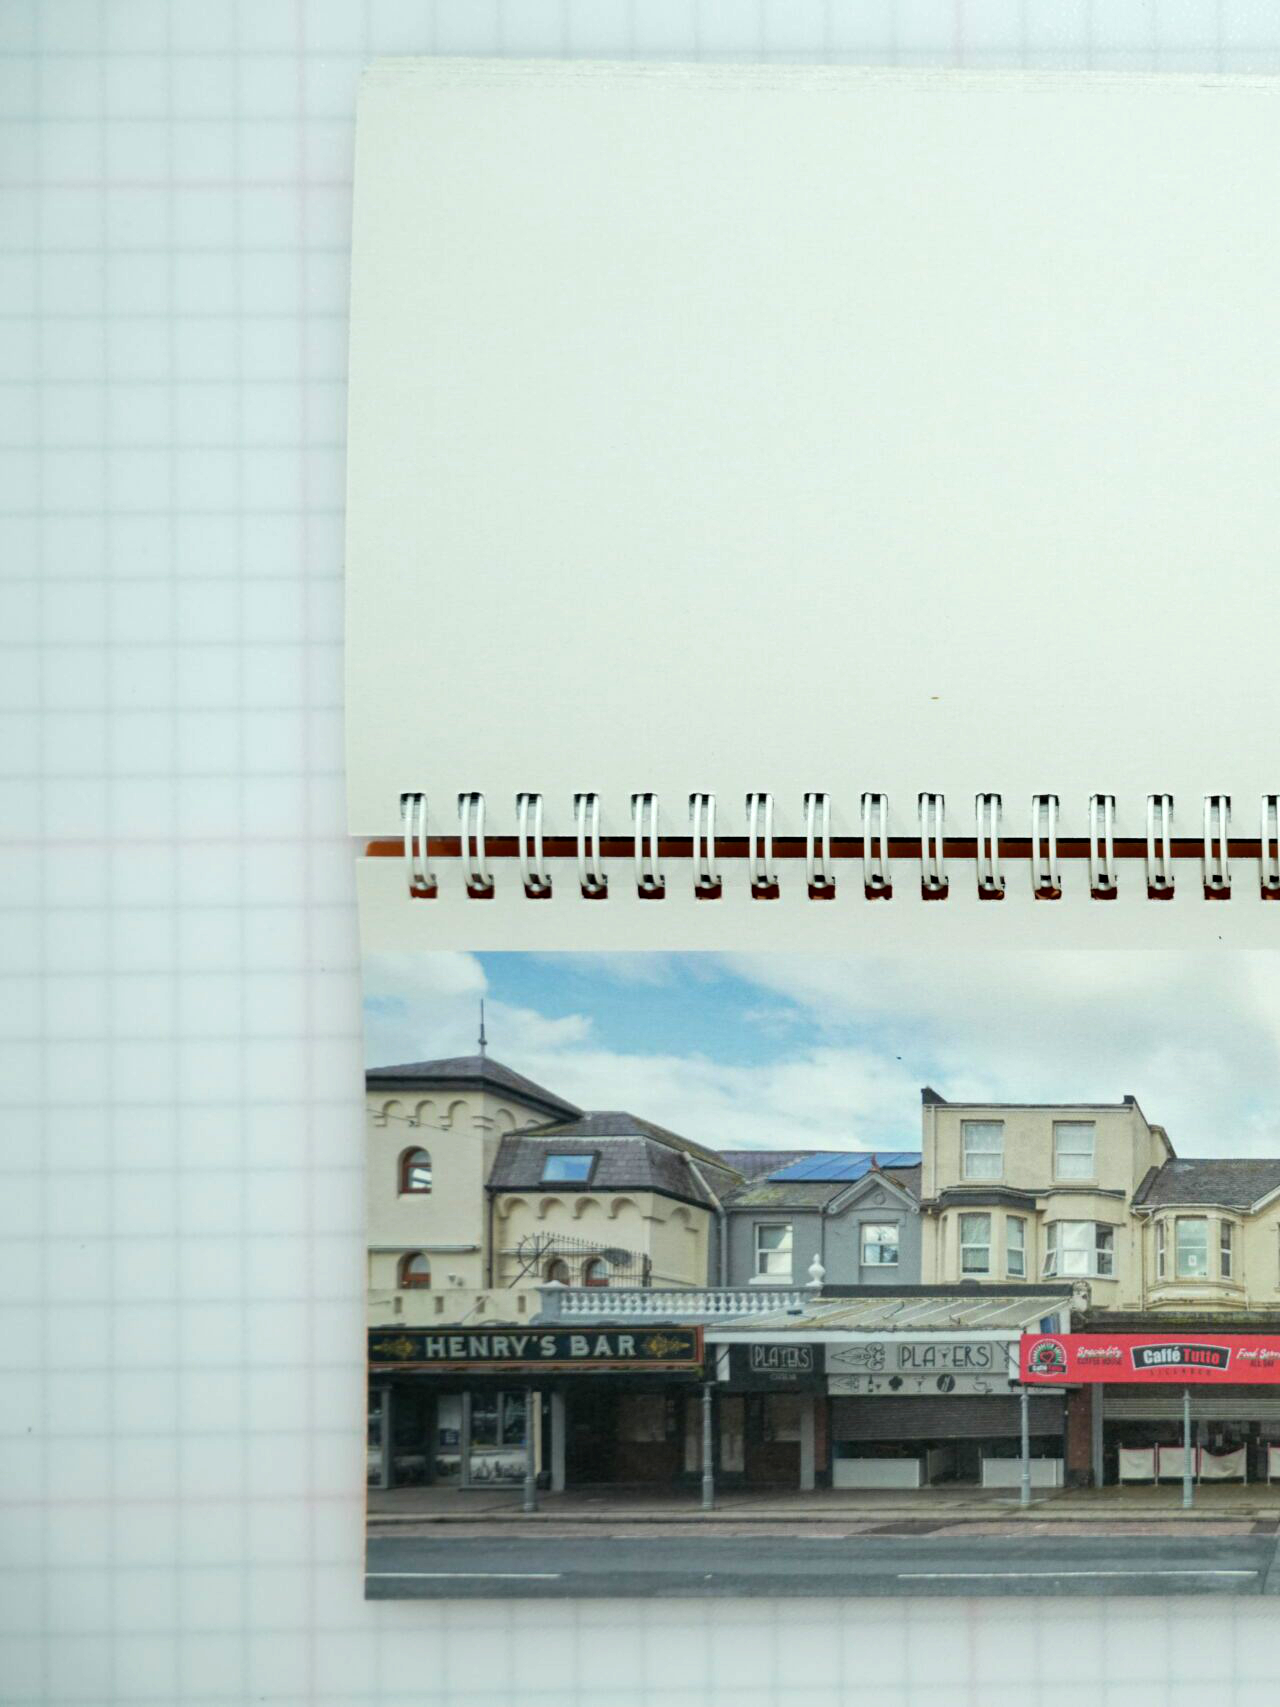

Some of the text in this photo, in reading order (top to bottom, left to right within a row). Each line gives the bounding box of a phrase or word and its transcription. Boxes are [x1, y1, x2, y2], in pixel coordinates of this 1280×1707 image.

[425, 1335, 637, 1358] HENRY'S BAR
[901, 1345, 990, 1368] PLAYERS
[1183, 1348, 1220, 1364] Tutto
